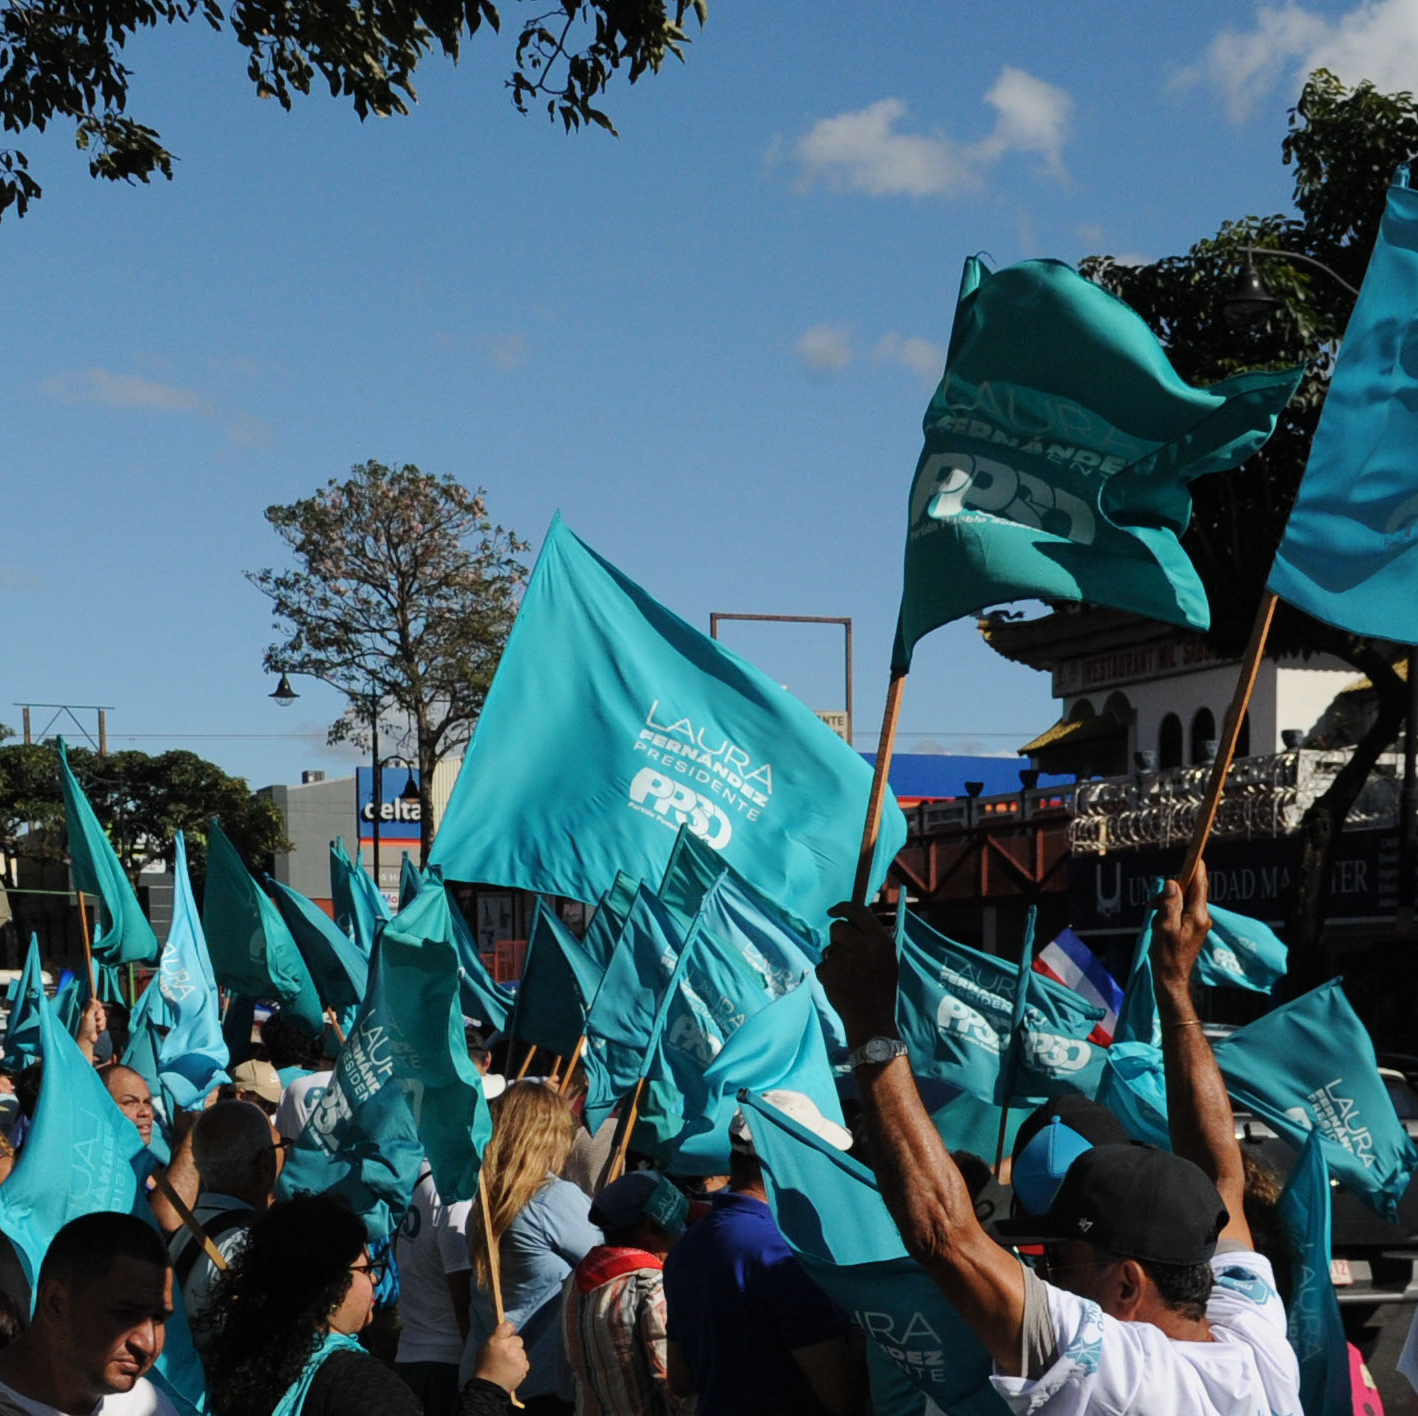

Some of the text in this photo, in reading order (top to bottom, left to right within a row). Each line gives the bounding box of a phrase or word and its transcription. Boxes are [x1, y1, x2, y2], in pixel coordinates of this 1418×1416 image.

[632, 741, 761, 823] PRESIDENTE
[639, 728, 769, 808] FERNÁNDEZ
[645, 699, 773, 795] LAURA
[943, 955, 1016, 998] LAUR
[1325, 1079, 1376, 1169] LAURA
